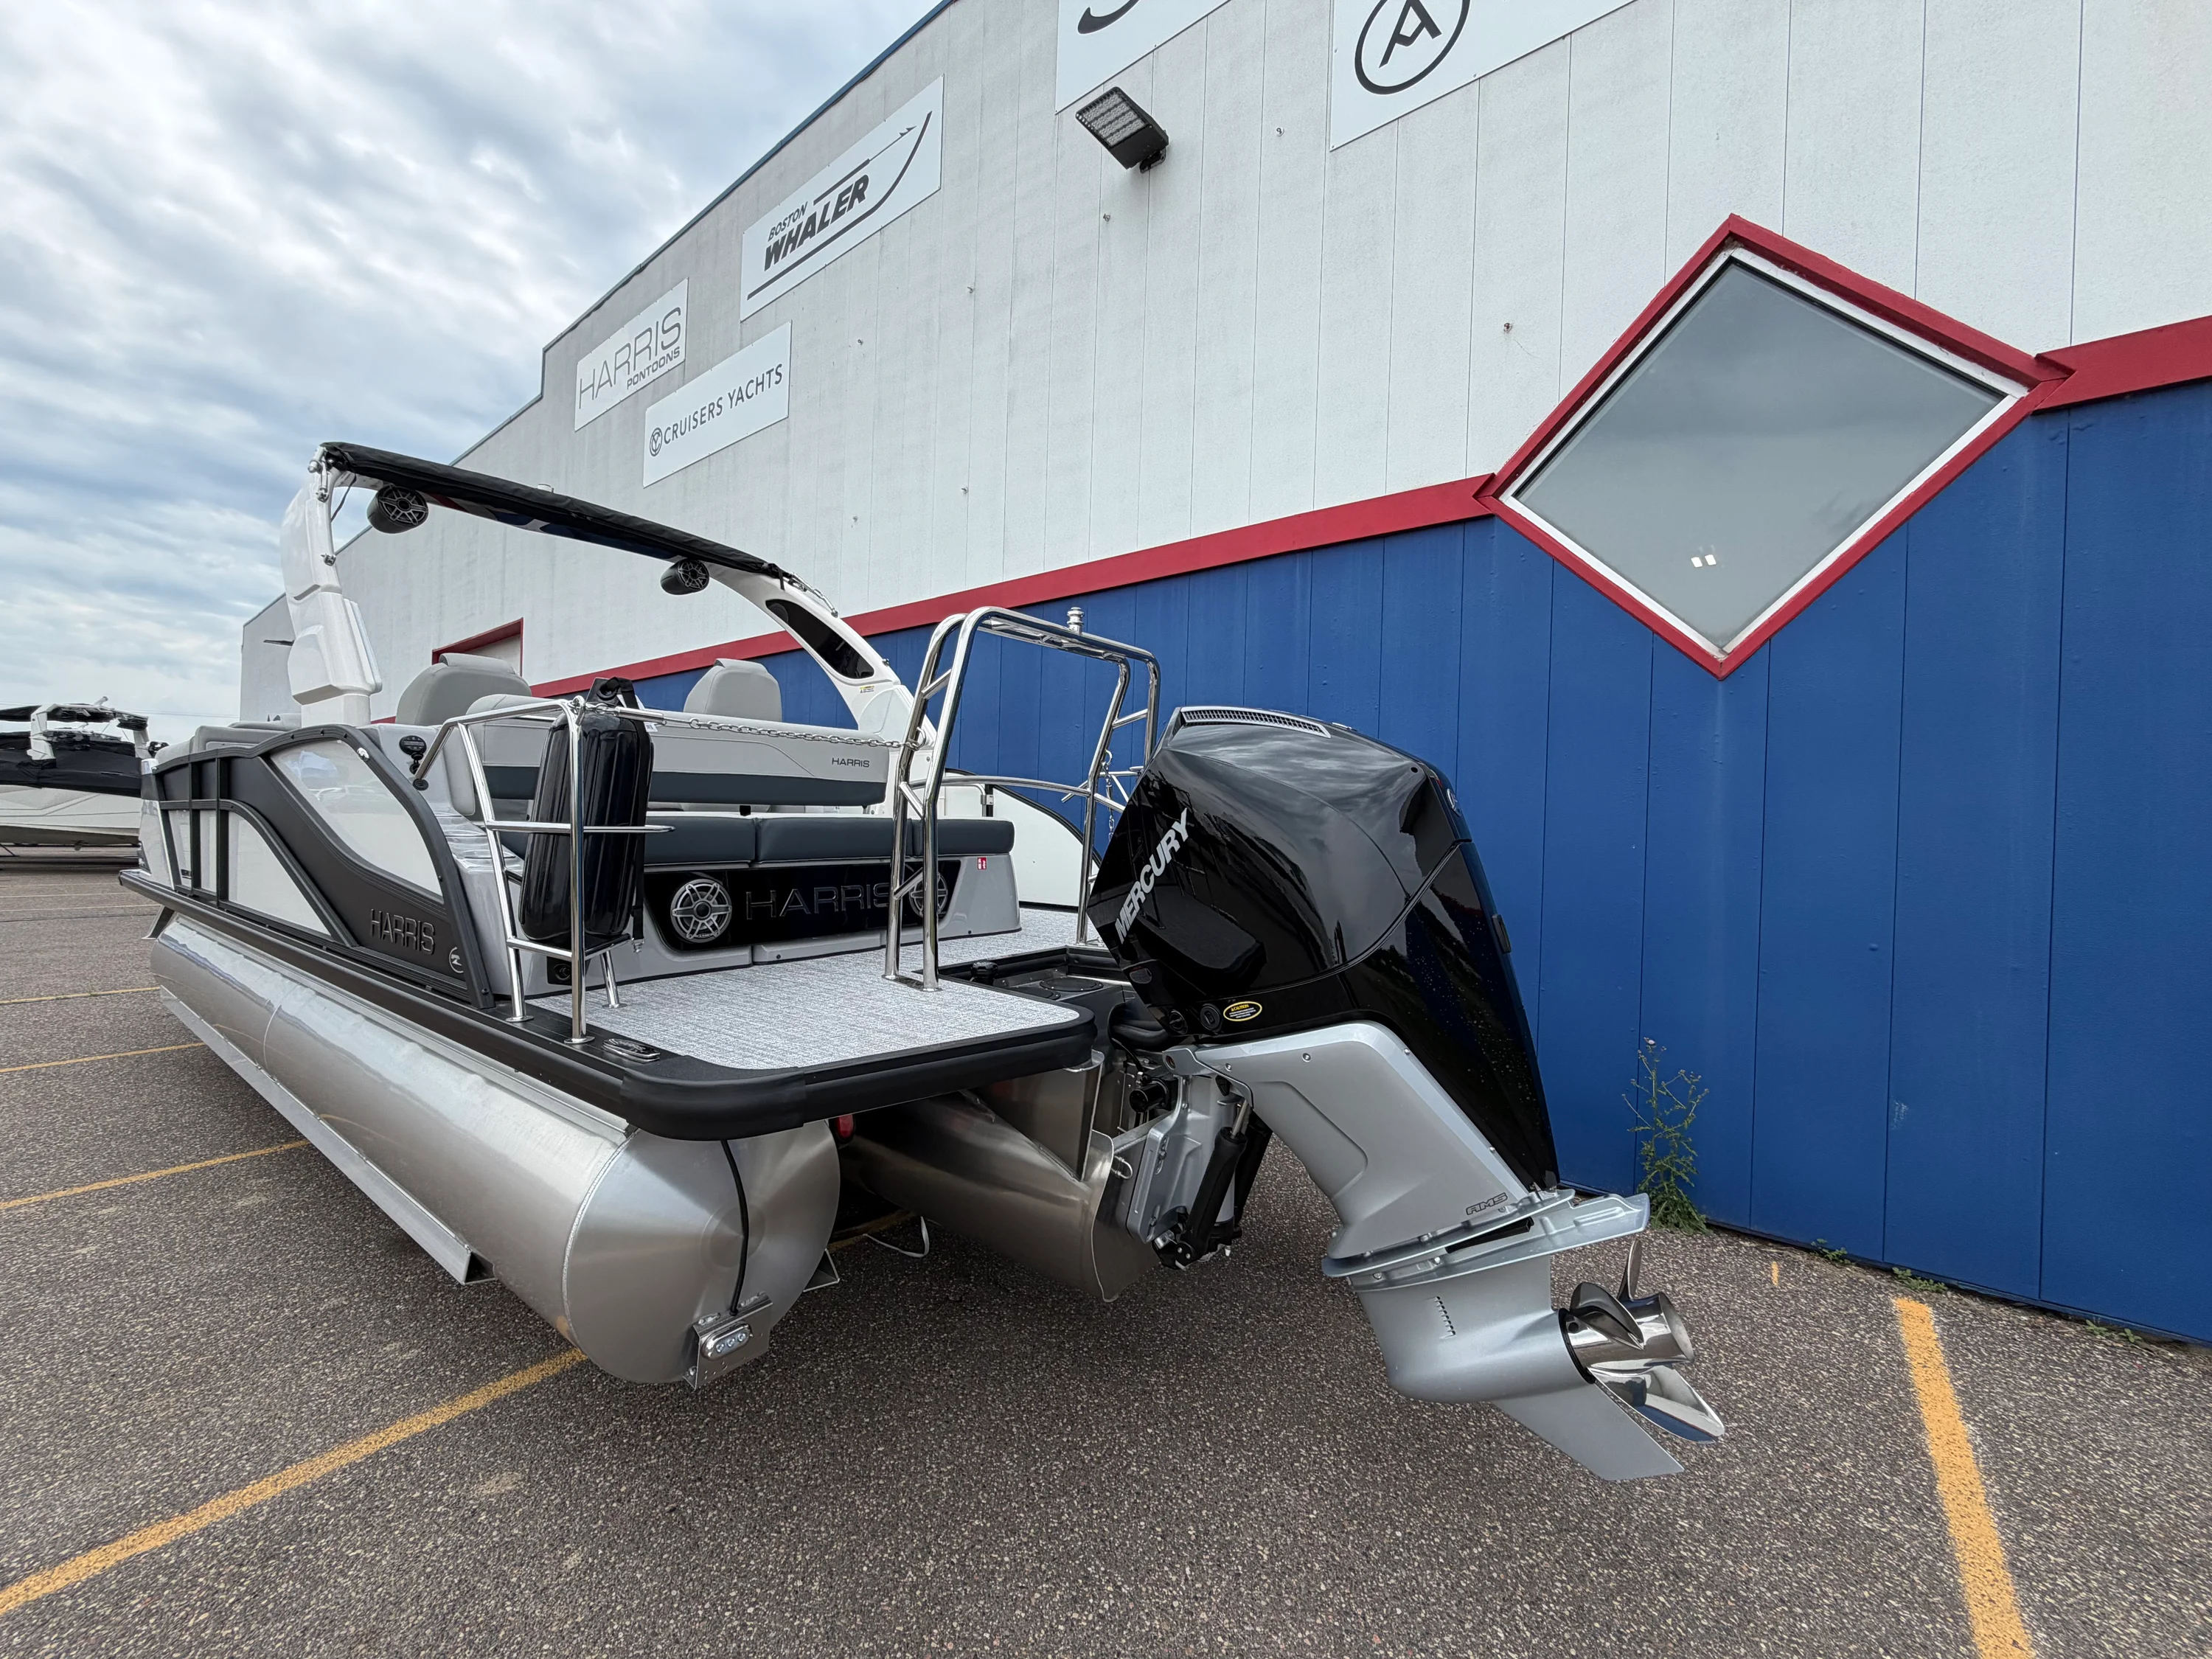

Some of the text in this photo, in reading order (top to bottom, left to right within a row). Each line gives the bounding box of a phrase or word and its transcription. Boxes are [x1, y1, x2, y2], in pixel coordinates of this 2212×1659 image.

[764, 174, 869, 271] WHALER
[768, 201, 808, 242] BOSTON
[579, 307, 681, 409] HARRIS
[626, 345, 681, 389] PONTOONS
[664, 397, 723, 445] CRUISERS
[728, 363, 783, 410] YACHTS
[832, 757, 870, 768] HARRIS
[1114, 807, 1190, 945] MERCURY
[745, 883, 891, 920] HARRIS
[370, 908, 436, 956] HARRIS
[1466, 1192, 1509, 1216] AMS
